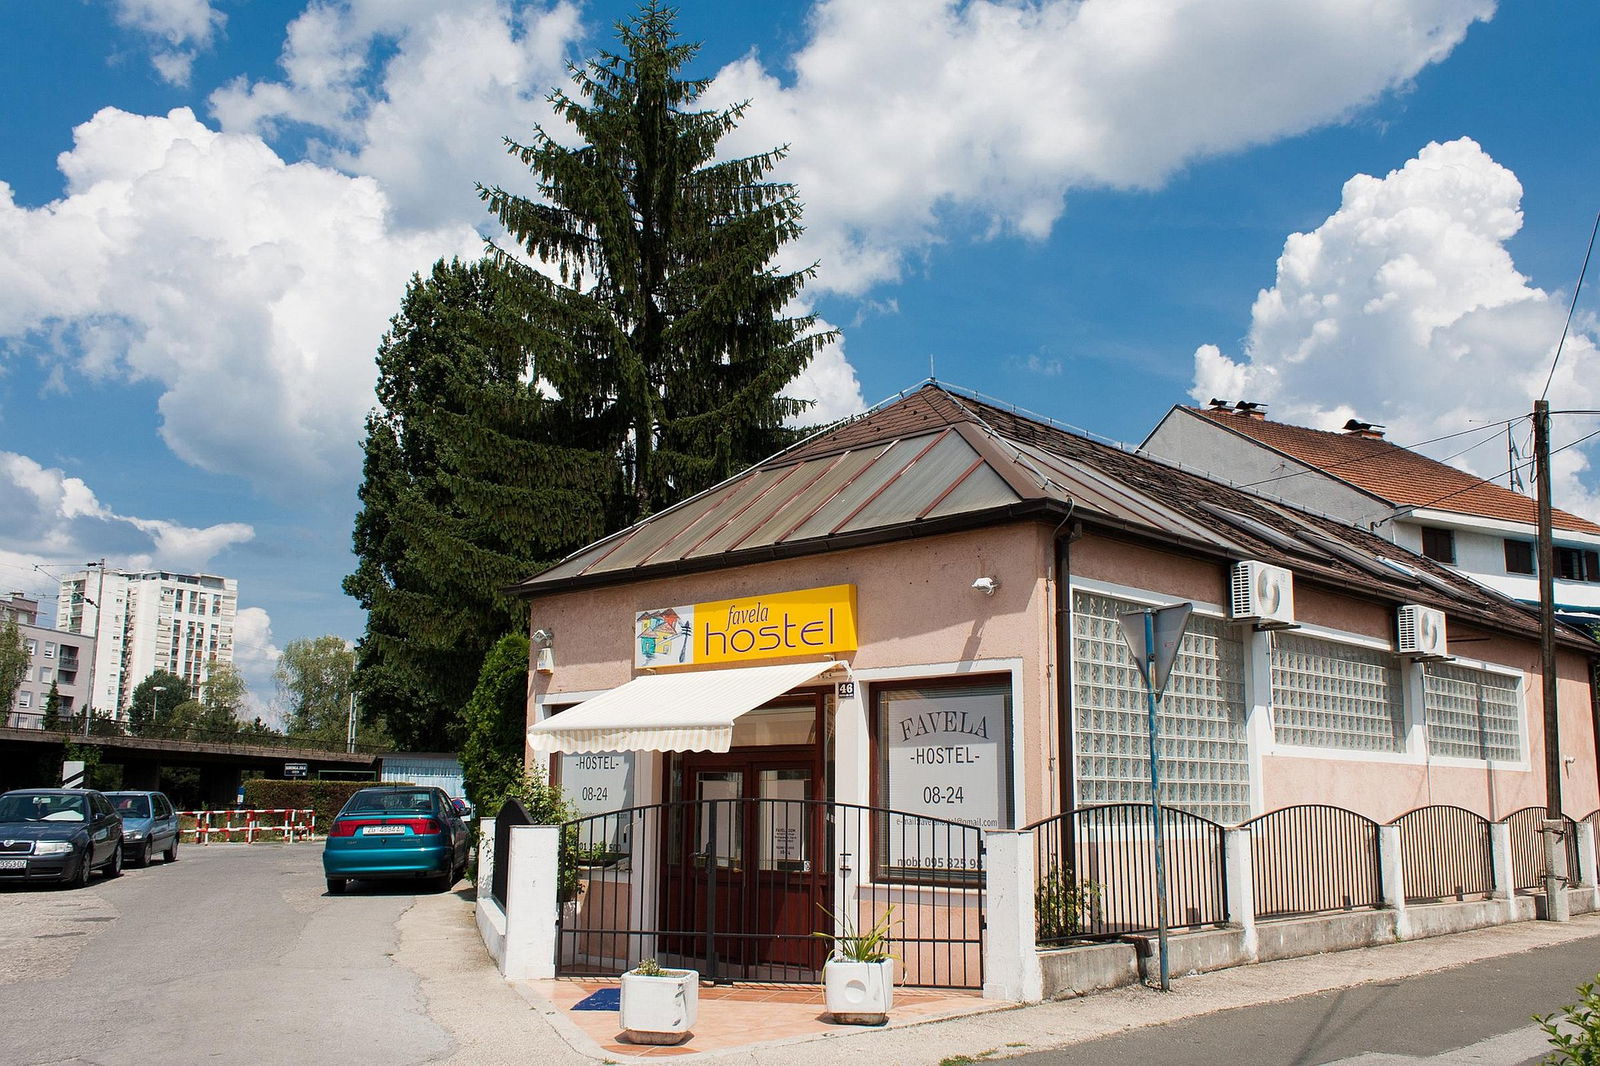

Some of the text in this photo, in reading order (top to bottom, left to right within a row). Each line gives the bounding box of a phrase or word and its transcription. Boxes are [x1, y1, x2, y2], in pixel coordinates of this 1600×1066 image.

[725, 602, 769, 631] favela
[706, 608, 833, 656] hostel
[839, 683, 853, 694] 46
[899, 710, 989, 742] FAVELA
[575, 756, 619, 770] -HOSTEL-
[910, 746, 980, 765] -HOSTEL-
[582, 786, 608, 801] 08-24
[923, 786, 964, 804] 08-24
